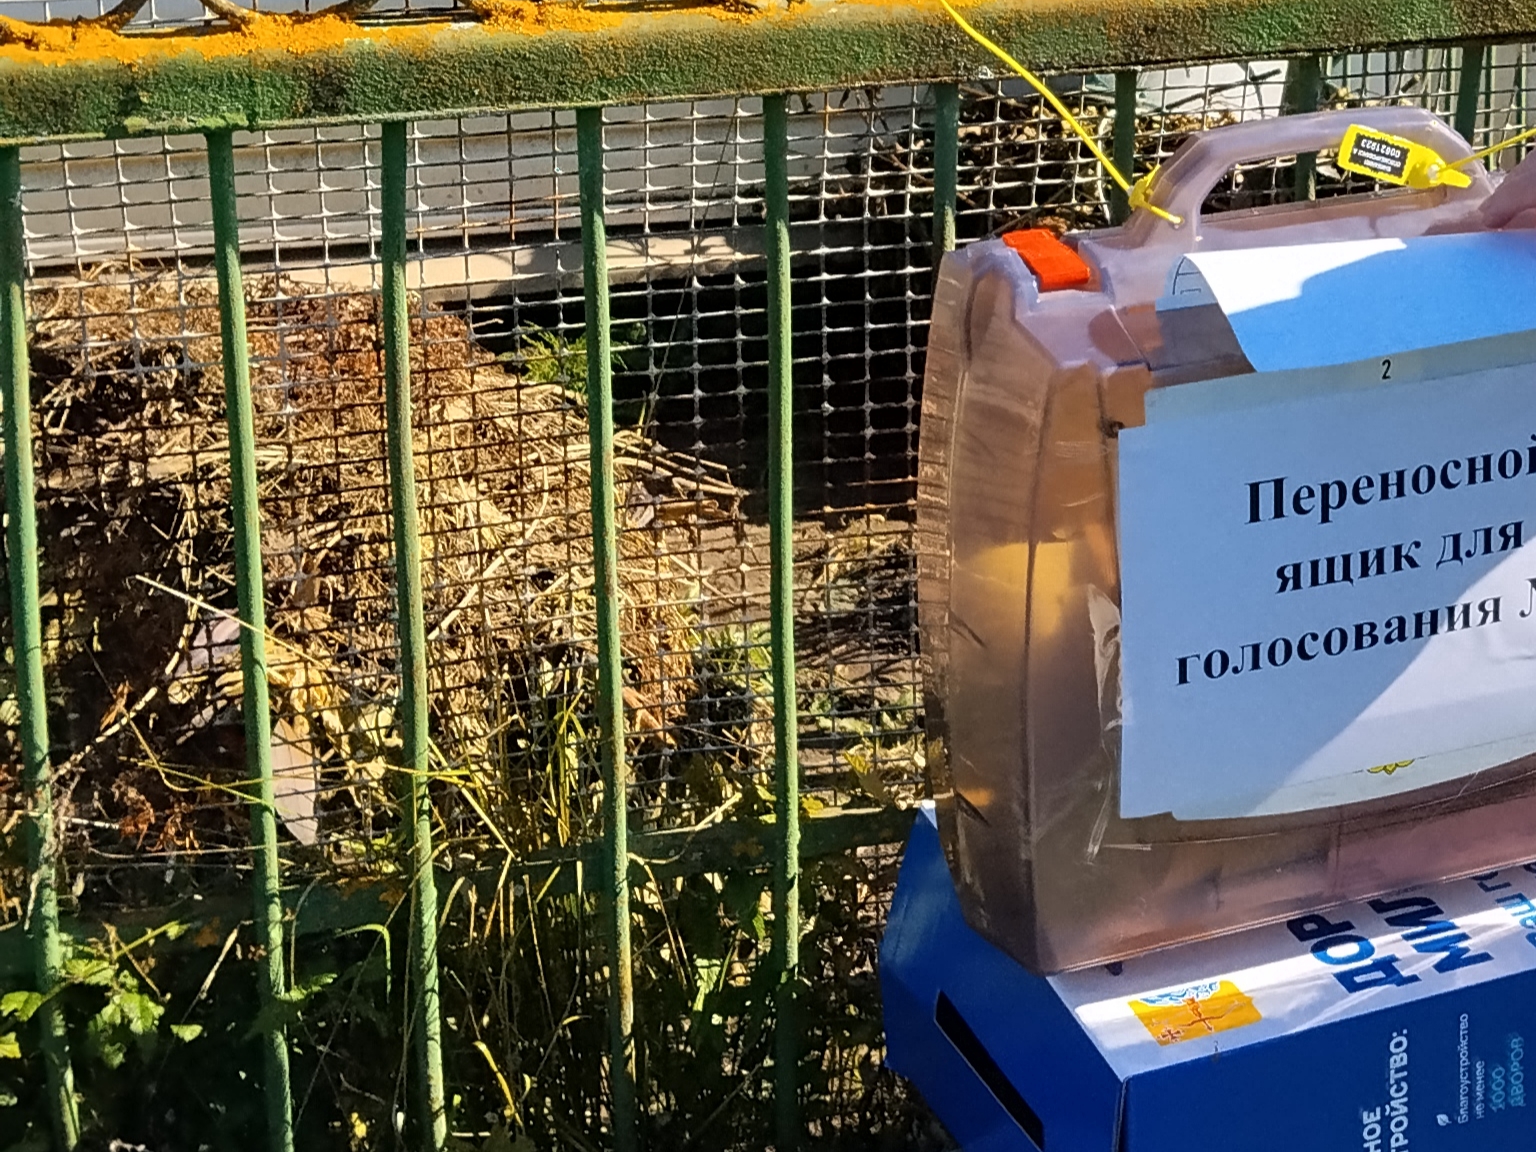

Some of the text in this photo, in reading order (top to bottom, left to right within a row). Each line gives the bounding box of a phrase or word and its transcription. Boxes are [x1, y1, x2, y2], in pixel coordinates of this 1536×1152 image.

[1381, 358, 1392, 380] 2
[1274, 520, 1526, 594] ящик для
[1175, 595, 1503, 686] голосования
[1457, 1013, 1471, 1124] Благоустройство
[1491, 1065, 1506, 1112] 1000
[1510, 1034, 1526, 1107] ДВОРОВ
